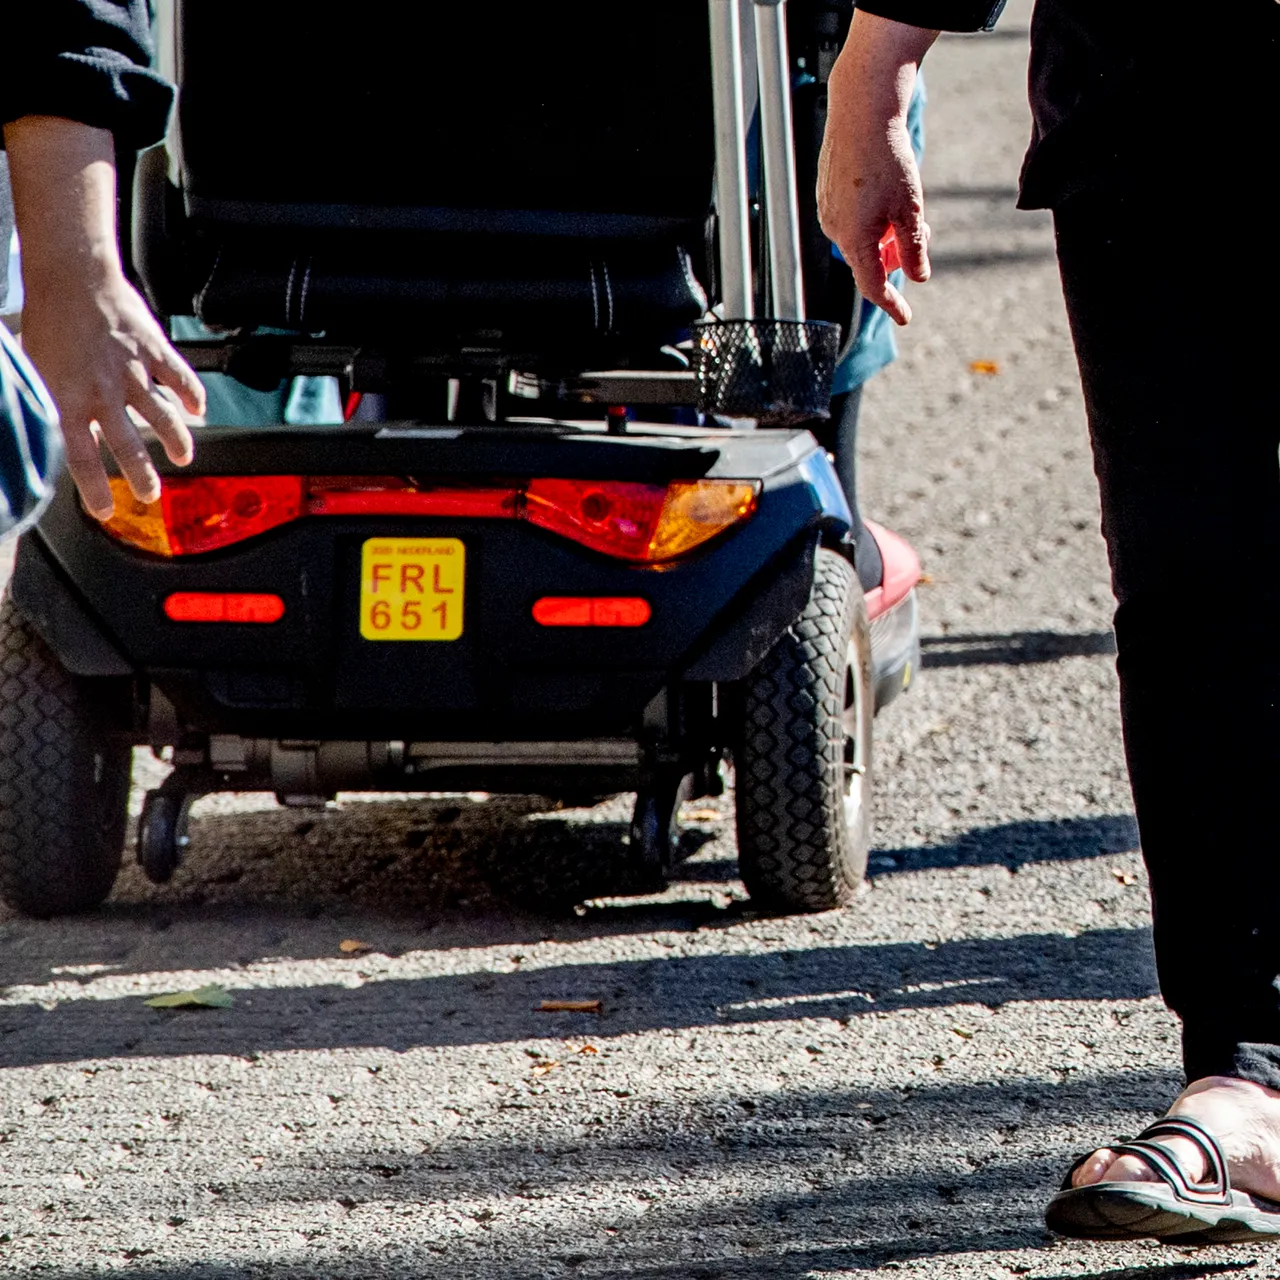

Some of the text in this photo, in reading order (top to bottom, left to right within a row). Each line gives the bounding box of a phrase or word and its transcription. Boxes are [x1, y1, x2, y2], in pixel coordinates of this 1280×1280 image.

[397, 545, 455, 556] NEDERLAND
[371, 563, 454, 594] FRL
[370, 600, 448, 631] 651
